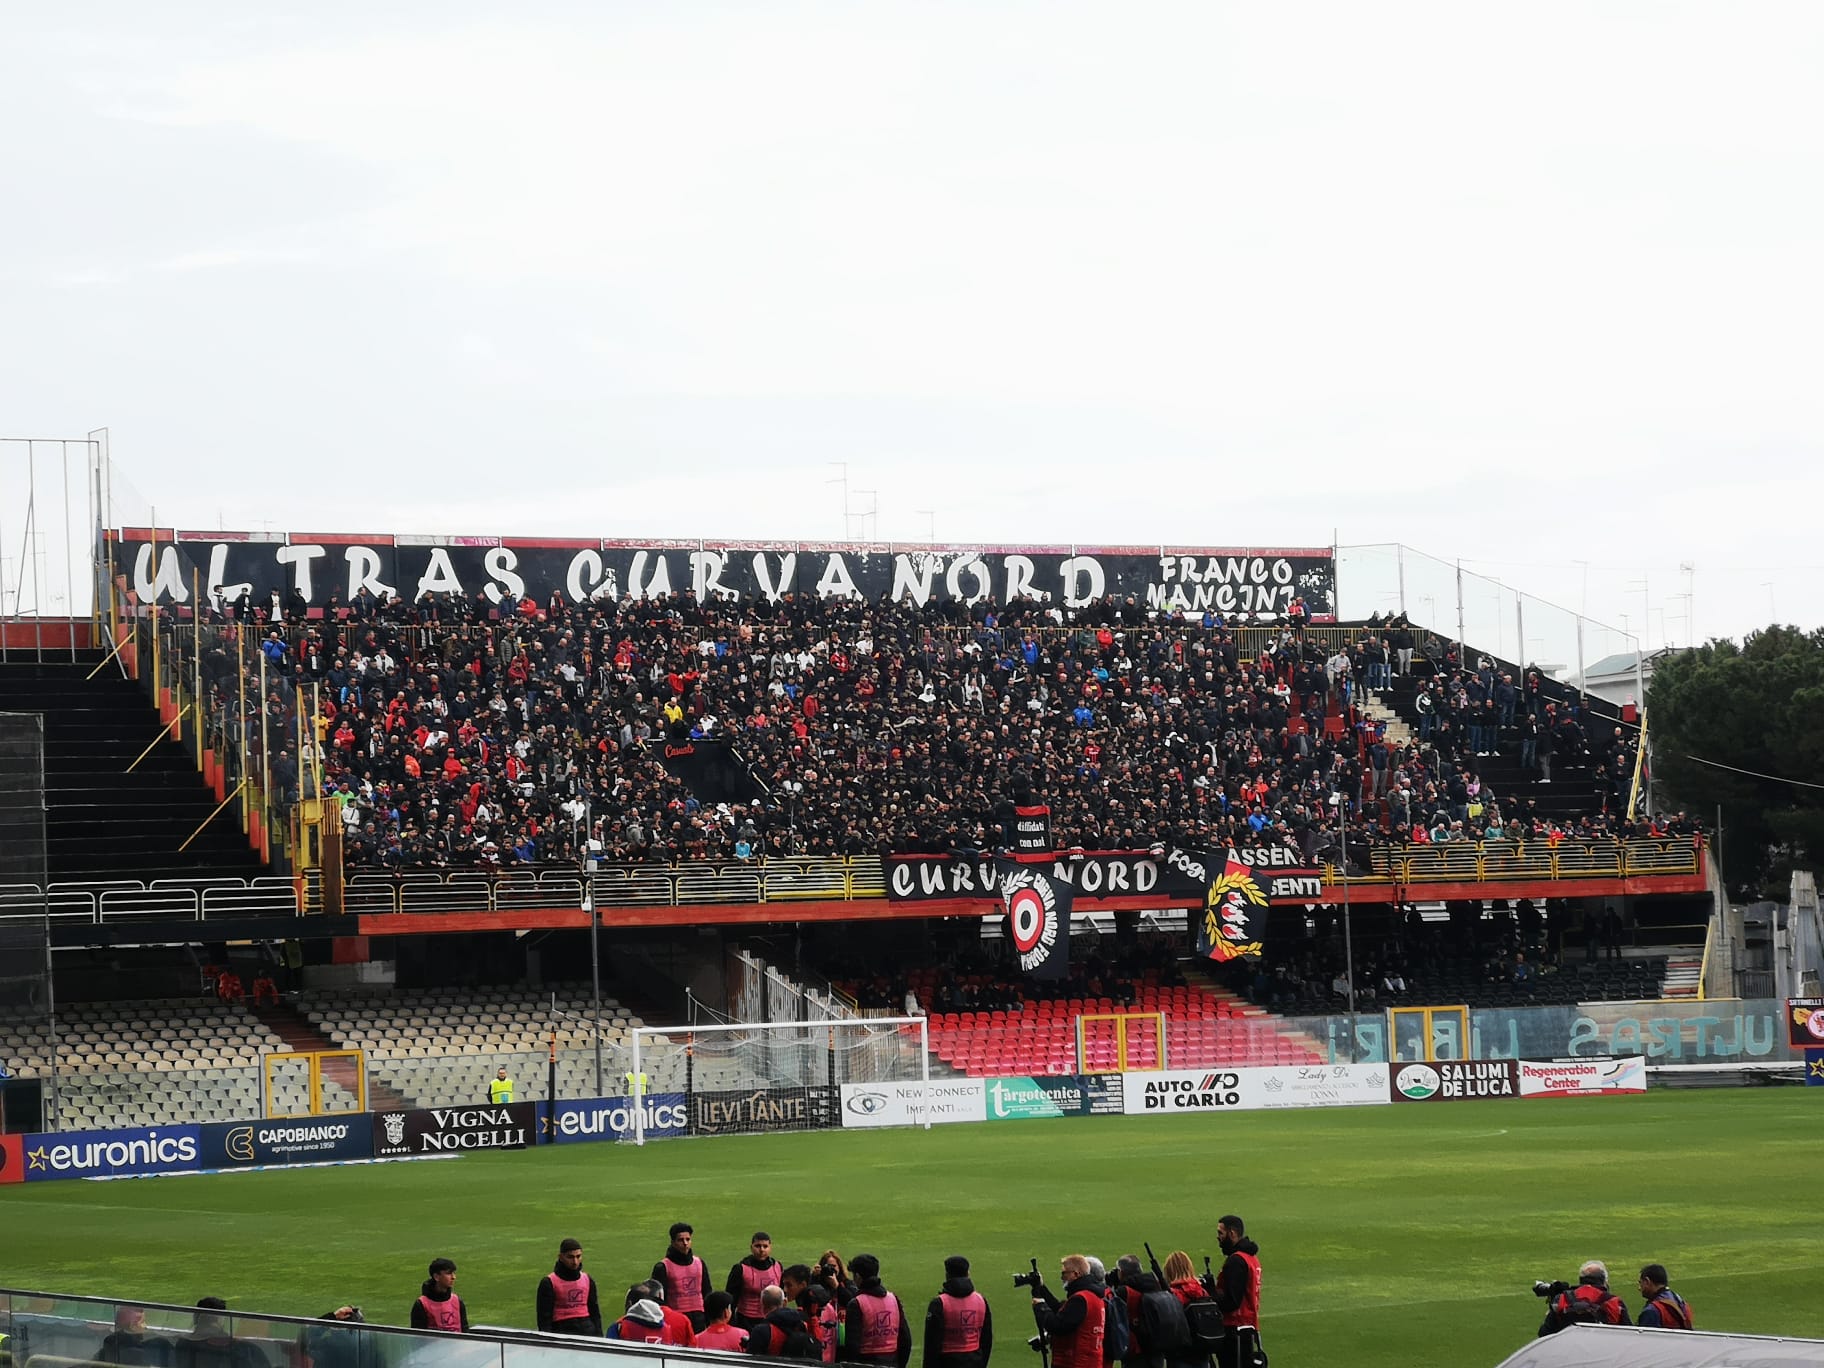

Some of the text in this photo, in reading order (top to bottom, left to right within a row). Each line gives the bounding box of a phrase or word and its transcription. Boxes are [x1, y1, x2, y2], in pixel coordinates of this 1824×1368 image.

[133, 543, 1106, 608] ULTRAS CURVA NORD
[1159, 556, 1293, 585] FRANCO
[1146, 582, 1296, 612] MANCINI
[1019, 839, 1032, 848] con
[891, 861, 998, 897] CURV
[1053, 860, 1158, 894] NORD
[1271, 878, 1321, 897] SENTI
[1297, 1067, 1327, 1083] Lady
[1441, 1063, 1509, 1081] SALUMI
[1522, 1064, 1597, 1078] Regeneration
[1144, 1080, 1194, 1094] AUTO
[1442, 1079, 1513, 1097] DE LUCA
[1544, 1078, 1581, 1089] Center
[896, 1088, 923, 1099] NEW
[989, 1080, 1082, 1117] targotecnica
[1145, 1092, 1240, 1109] DI CARLO
[430, 1108, 514, 1129] VIGNA
[560, 1099, 688, 1135] euronics
[906, 1104, 955, 1114] IMPANTI
[258, 1125, 346, 1144] CAPOBIANCO
[419, 1128, 526, 1151] NOCELLI
[49, 1131, 197, 1170] euronics
